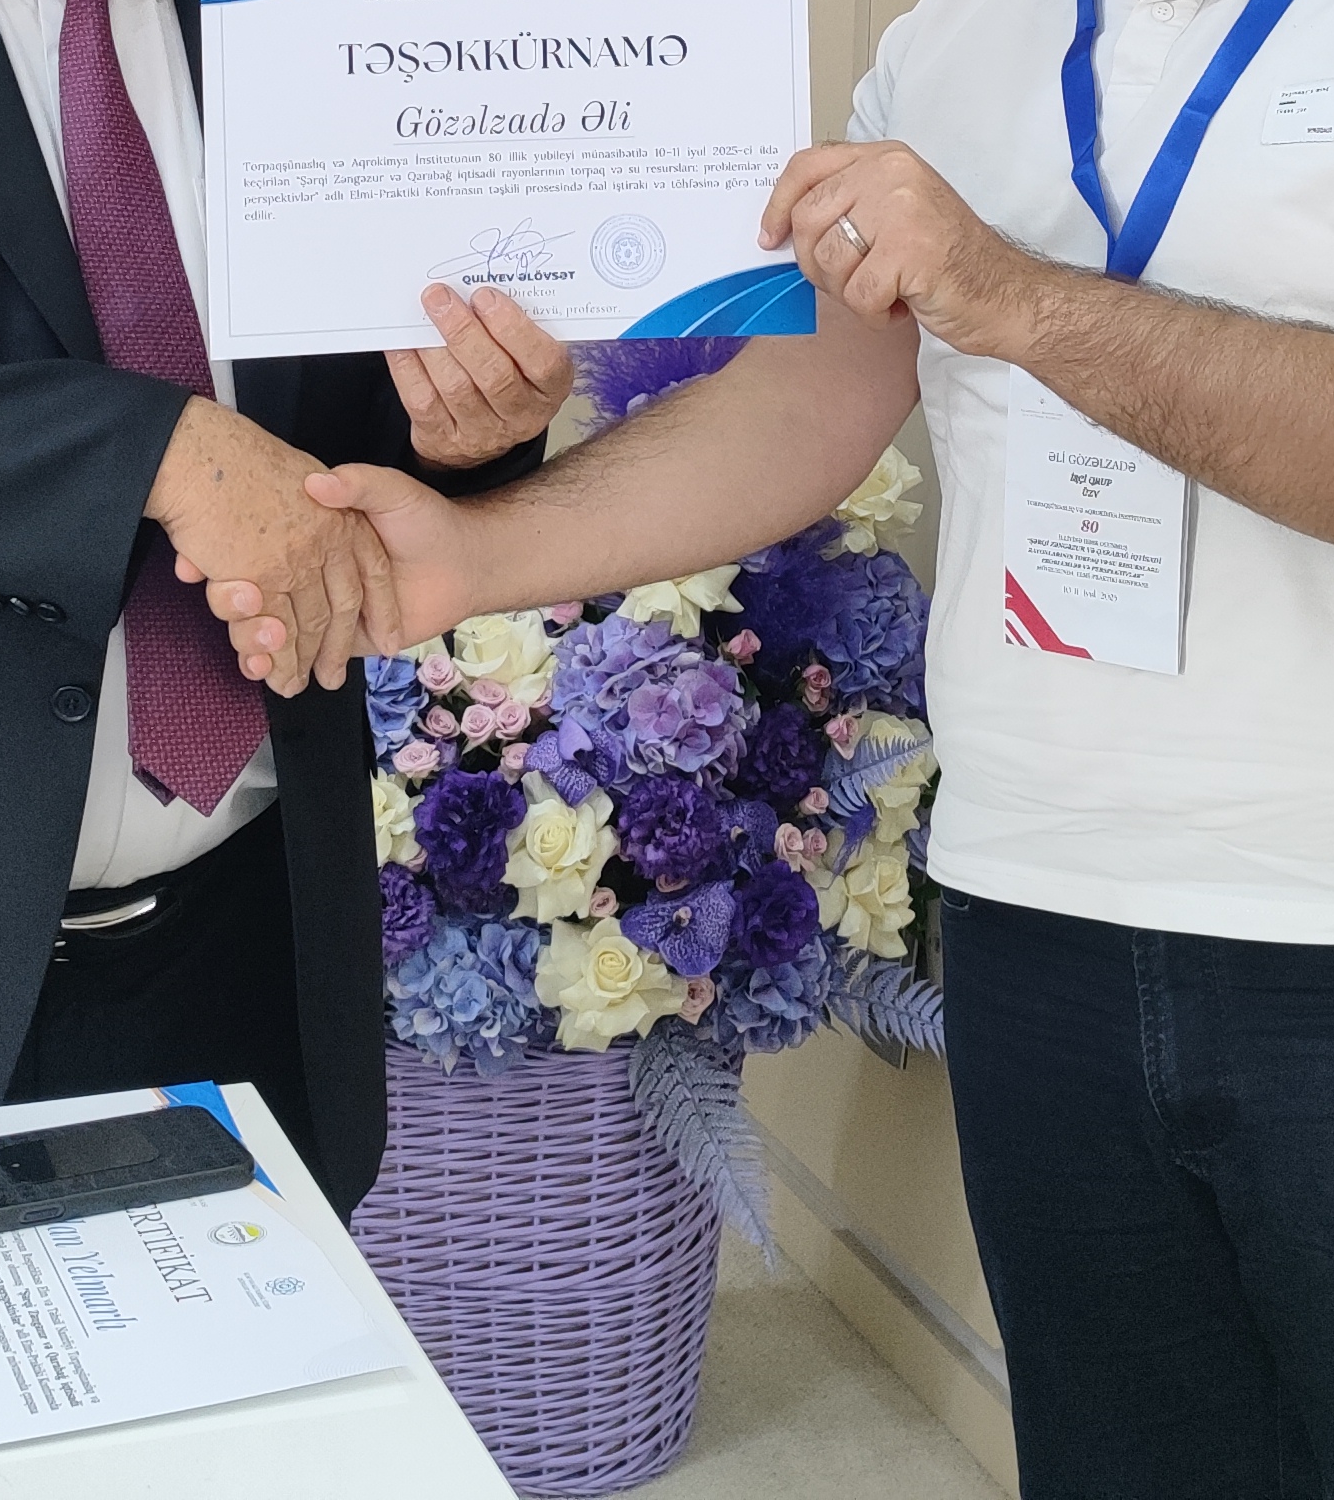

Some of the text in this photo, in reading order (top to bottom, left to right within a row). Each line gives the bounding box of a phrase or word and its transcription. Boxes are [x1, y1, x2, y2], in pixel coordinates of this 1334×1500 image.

[338, 32, 688, 83] TƏŞƏKKÜRNAMƏ
[397, 100, 633, 138] Gözəlzadə Əli
[333, 160, 345, 168] və
[351, 156, 408, 169] Aqrokimya
[489, 152, 502, 162] 80
[509, 150, 527, 162] illik
[533, 150, 575, 163] yubileyi
[654, 147, 681, 158] 10-11
[687, 146, 706, 159] iyul
[712, 145, 752, 156] 2025-ci
[244, 175, 290, 190] keçirilən
[333, 173, 384, 186] Zəngəzur
[390, 174, 402, 182] və
[458, 168, 496, 182] iqtisadi
[571, 164, 606, 177] torpaq
[611, 166, 623, 175] və
[628, 165, 640, 174] su
[703, 161, 762, 175] problemlər
[767, 162, 779, 171] və
[325, 189, 344, 200] adlı
[525, 182, 583, 195] prosesində
[654, 182, 666, 190] və
[725, 178, 749, 191] görə
[244, 209, 275, 221] edilir.
[462, 269, 576, 285] QULİYEV ƏLÖVSƏT
[509, 287, 556, 298] Direktor
[566, 304, 621, 317] professor.
[1048, 450, 1136, 472] ƏLİ GÖZƏLZADƏ
[1080, 520, 1099, 533] 80
